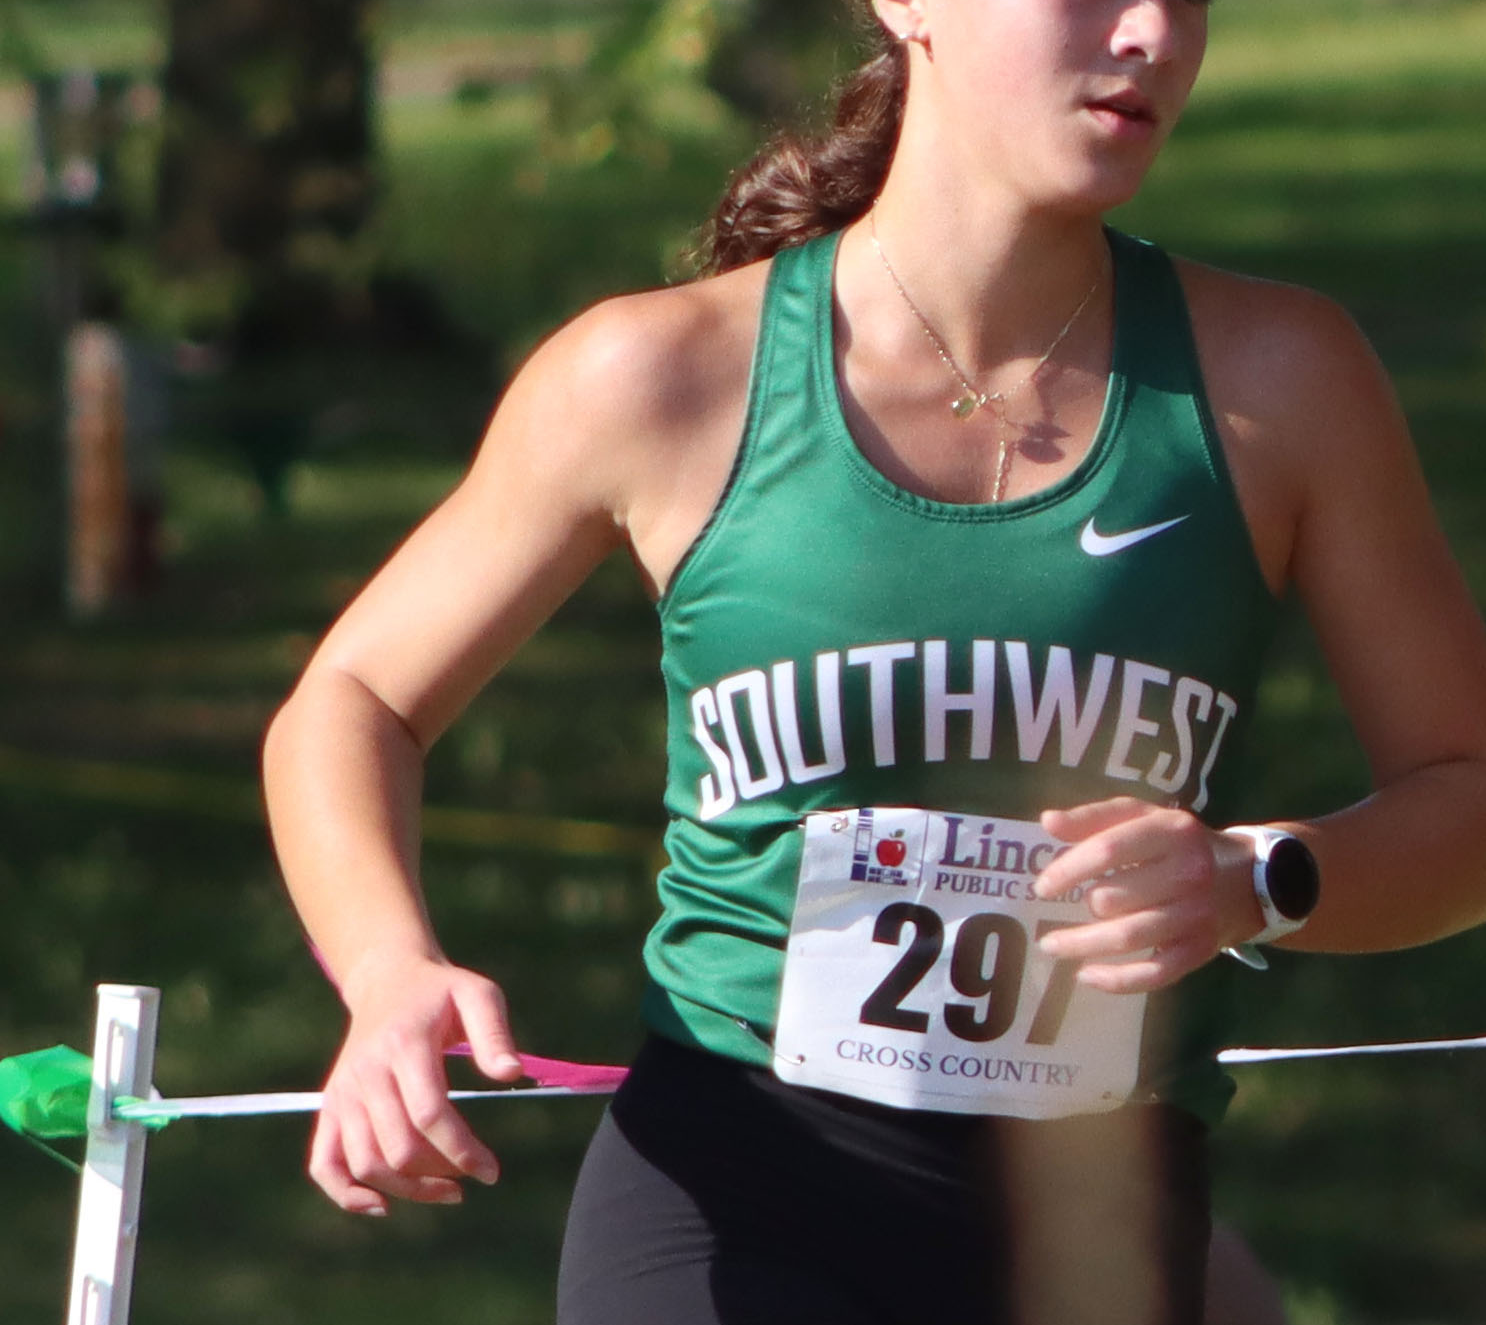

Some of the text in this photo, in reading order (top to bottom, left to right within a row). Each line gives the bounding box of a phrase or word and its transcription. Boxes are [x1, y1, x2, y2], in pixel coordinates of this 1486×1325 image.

[690, 639, 1238, 821] SOUTHWEST
[938, 816, 1073, 876] Linc
[934, 871, 1020, 900] PUBLIC
[859, 901, 1096, 1047] 297
[836, 1039, 1082, 1087] CROSS COUNTRY
